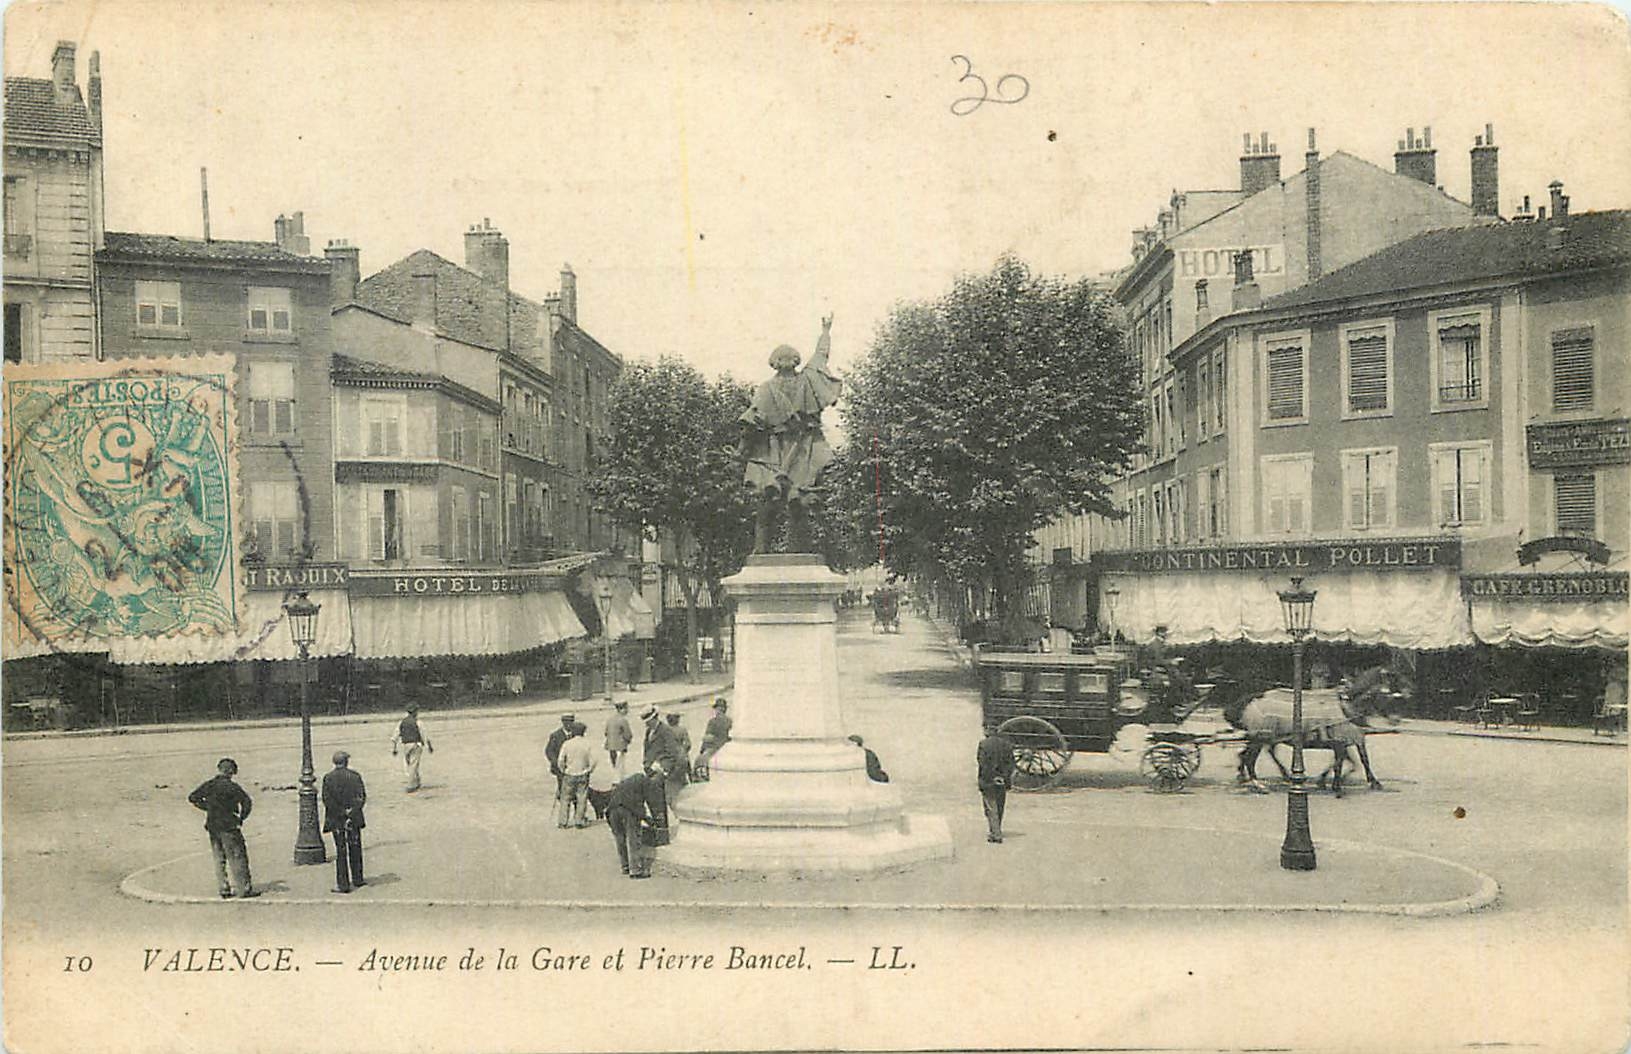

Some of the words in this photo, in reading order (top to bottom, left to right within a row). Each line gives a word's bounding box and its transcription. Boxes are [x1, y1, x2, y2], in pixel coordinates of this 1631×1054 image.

[950, 54, 1030, 116] 30
[72, 380, 164, 403] POSTES
[1331, 545, 1439, 567] POLLET
[394, 578, 482, 593] HOTEL
